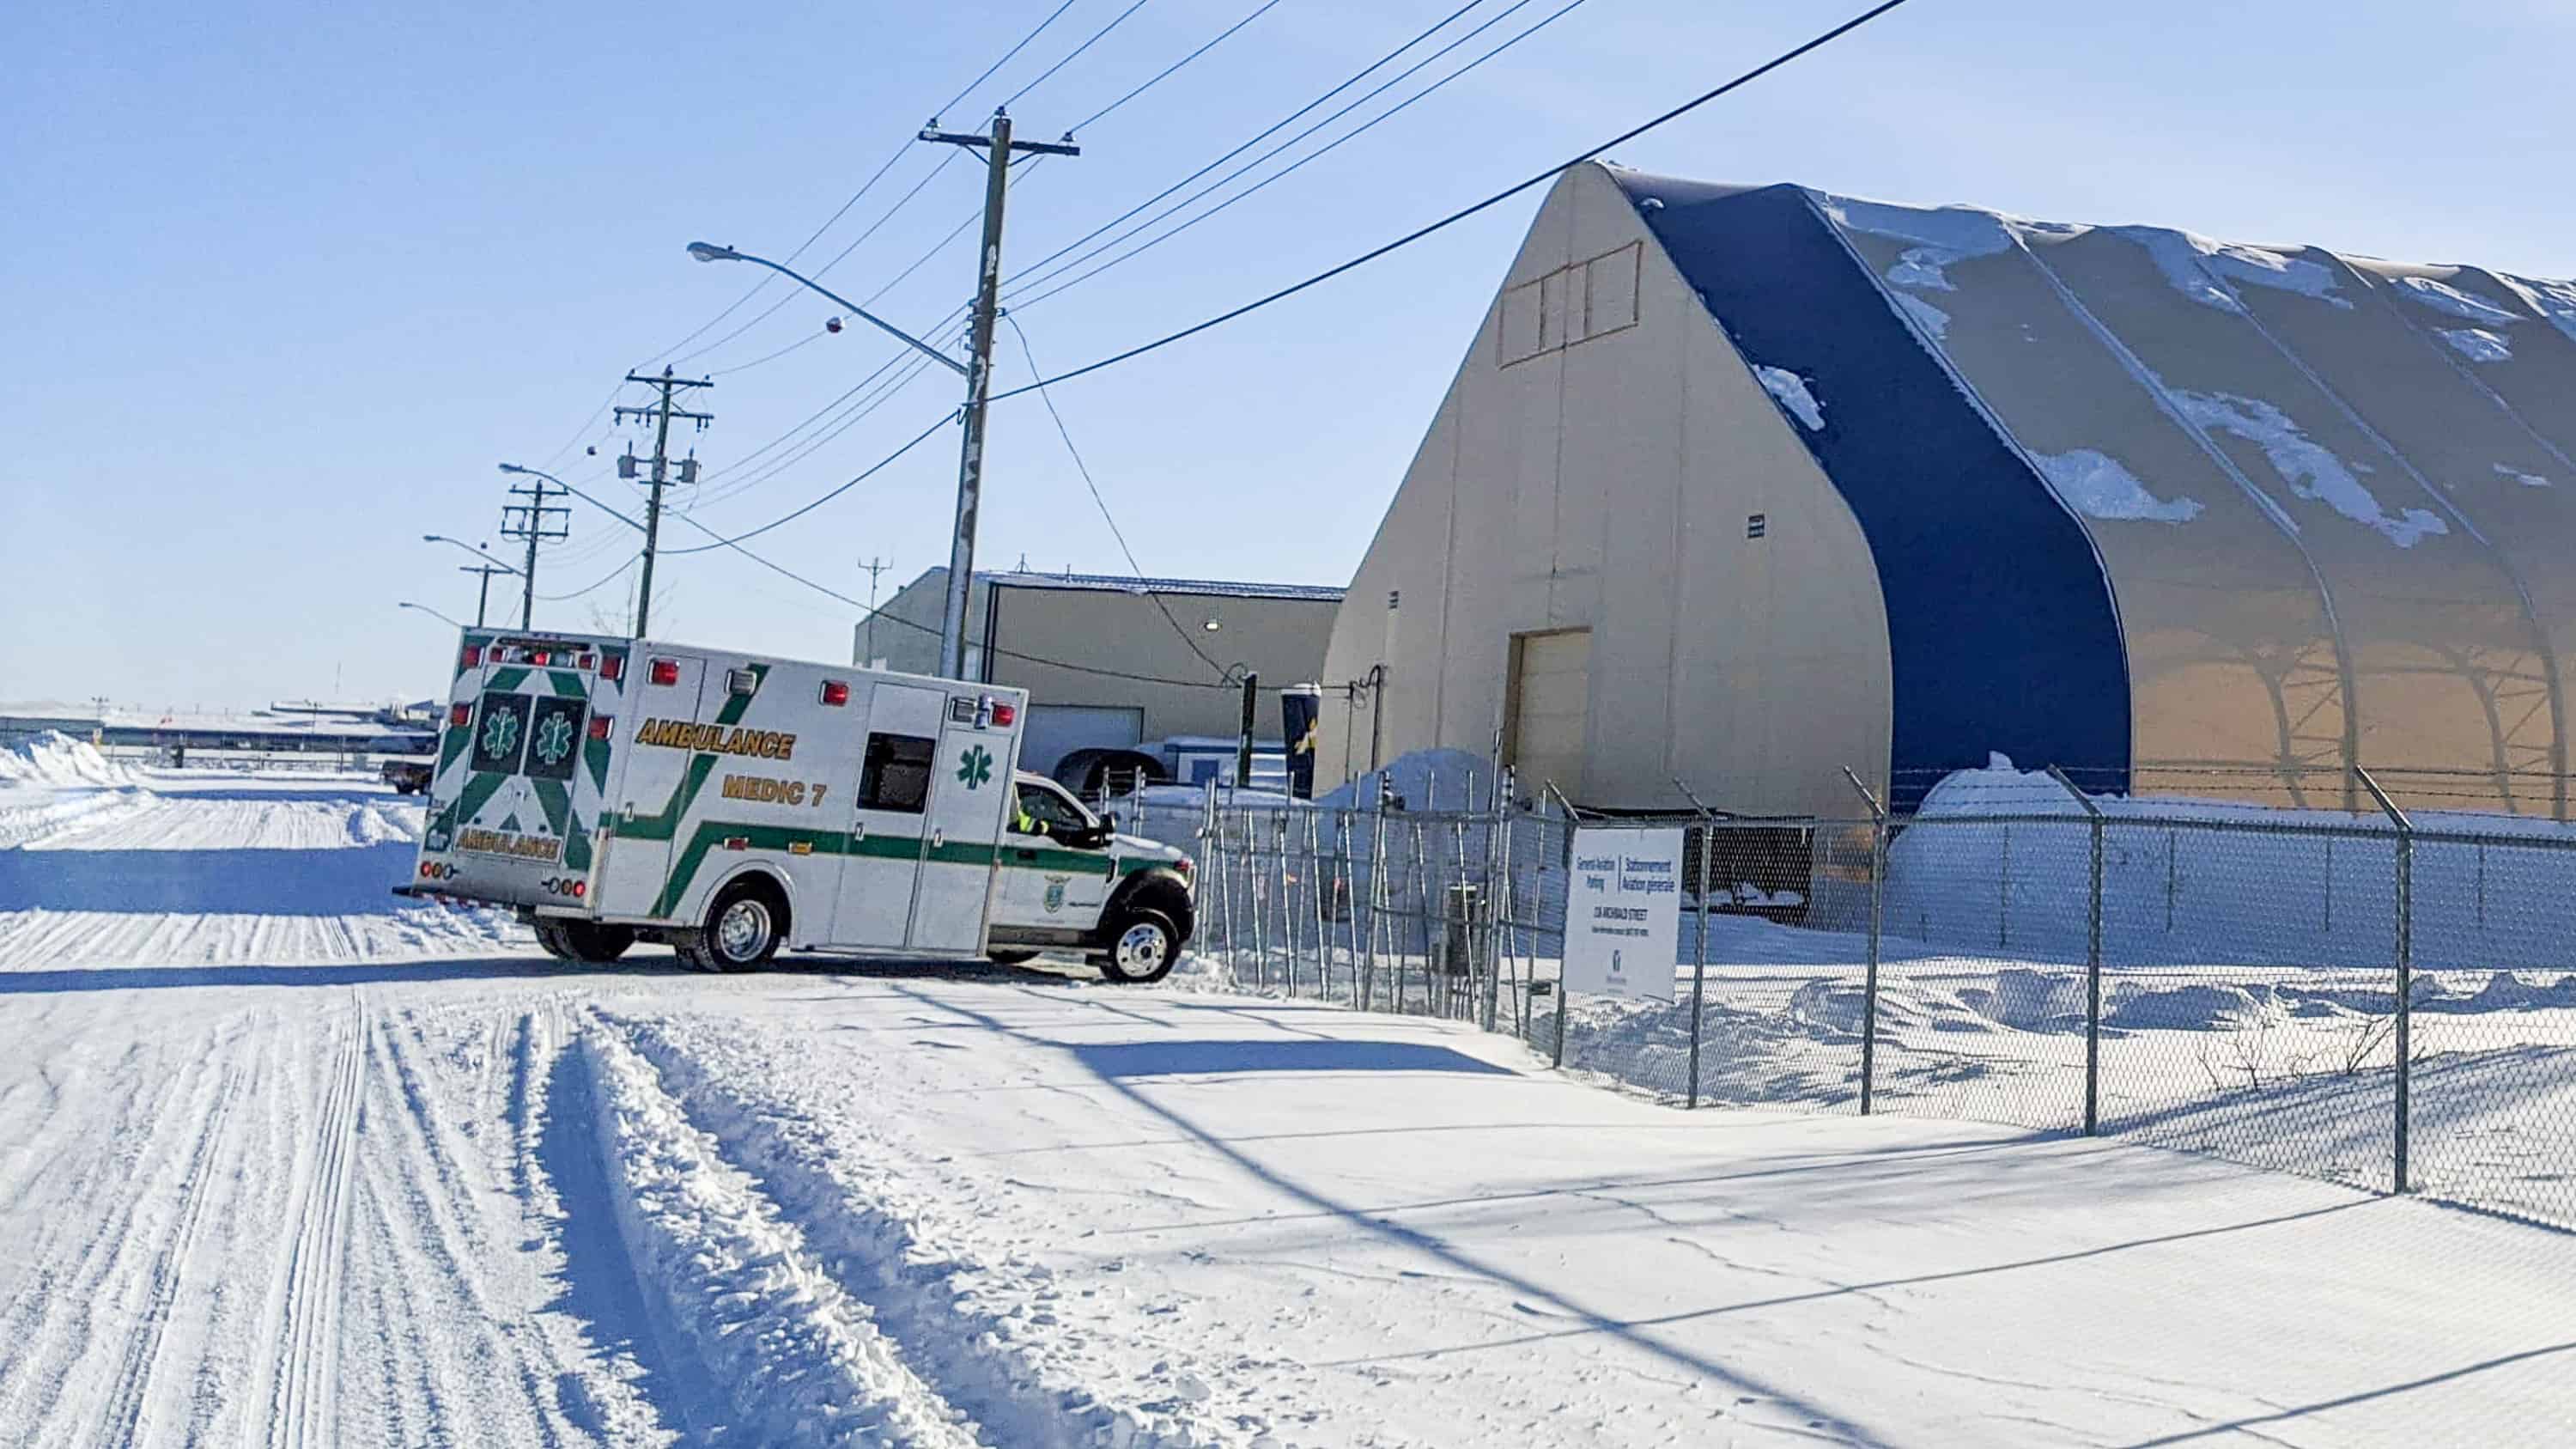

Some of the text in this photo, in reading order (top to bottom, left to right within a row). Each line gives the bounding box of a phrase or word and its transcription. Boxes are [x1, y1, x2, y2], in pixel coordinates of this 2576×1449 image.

[635, 718, 796, 760] AMBULANCE
[721, 775, 827, 807] MEDIC 7
[458, 828, 561, 859] AMBULANCE
